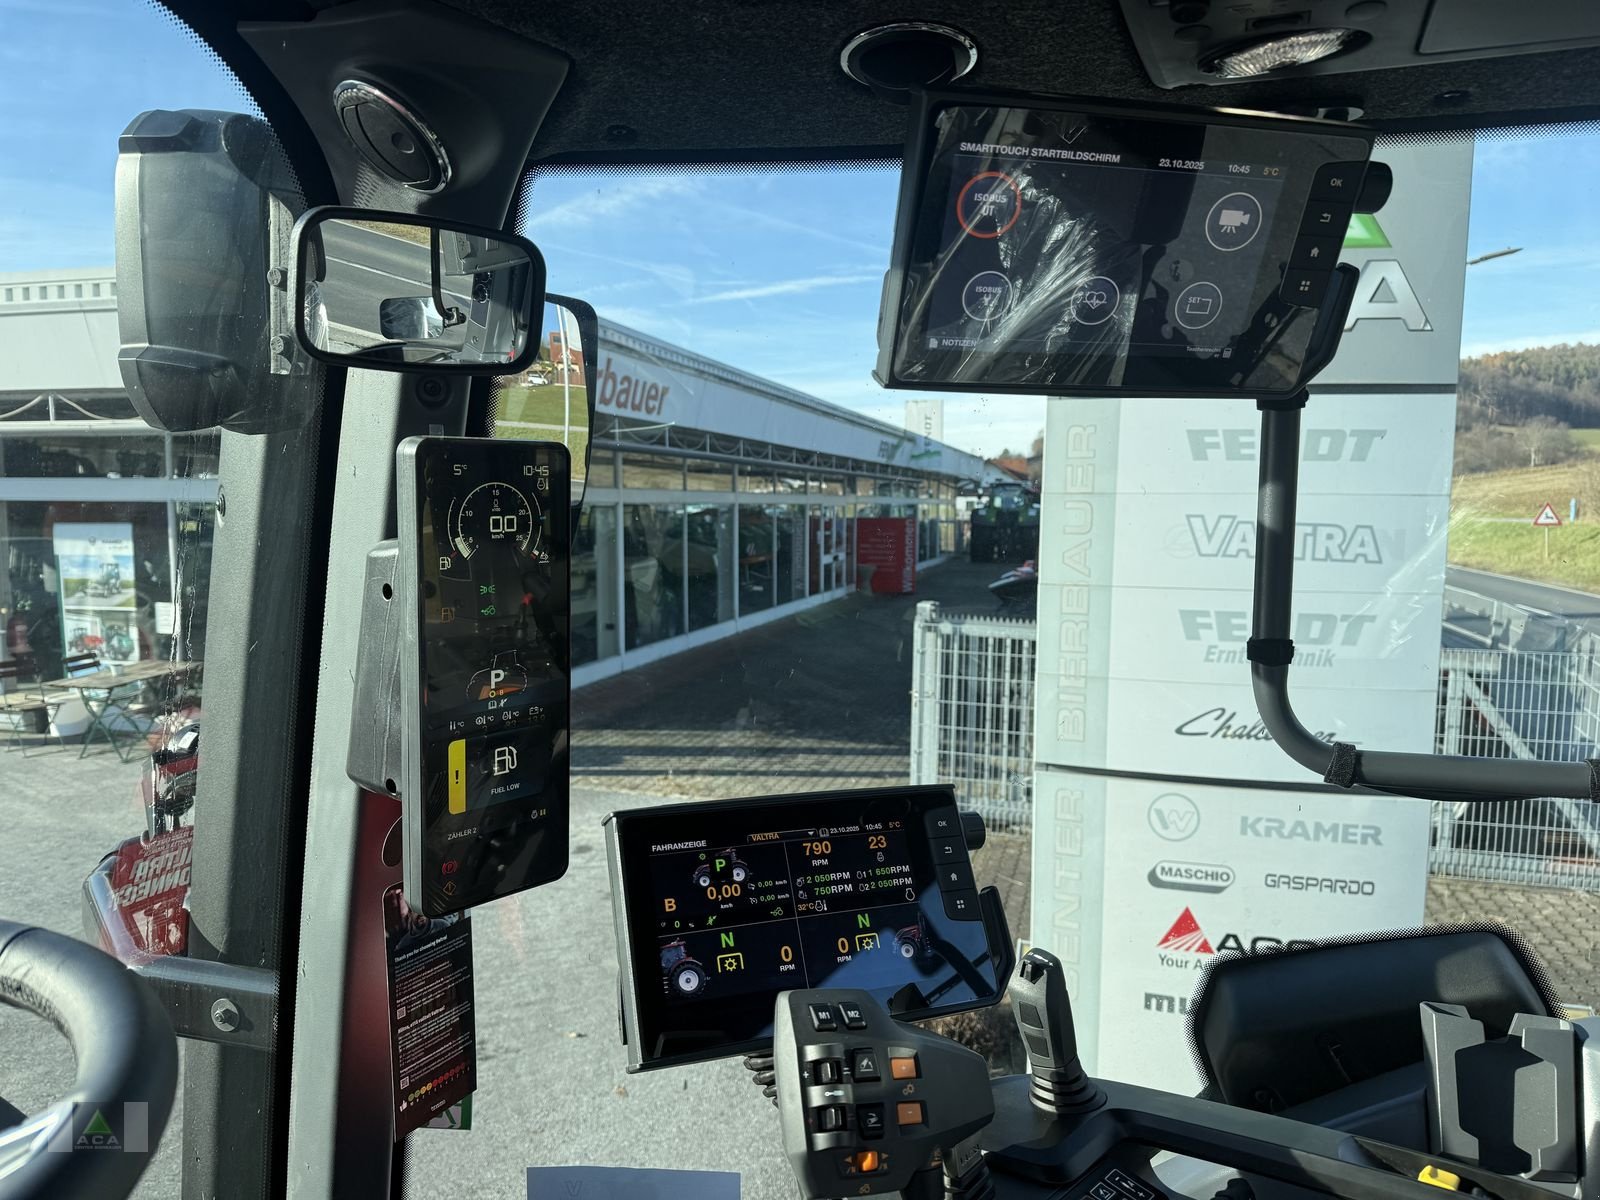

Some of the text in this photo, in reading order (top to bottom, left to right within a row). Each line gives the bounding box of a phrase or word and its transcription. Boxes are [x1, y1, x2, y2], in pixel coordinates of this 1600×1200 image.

[960, 142, 1120, 163] SMARTTOUCH STARTBILDSCHIRM
[1158, 158, 1280, 176] 23.10.2025 10:45 5°C
[1330, 178, 1343, 187] OK
[941, 339, 977, 347] NOTIZEN
[1185, 429, 1388, 462] FEDT
[453, 464, 468, 476] 5°C
[523, 465, 550, 476] 10:45
[1185, 514, 1383, 564] VATRA
[1057, 424, 1097, 743] BIERBAUER
[1178, 609, 1377, 647] FEDT
[491, 669, 505, 689] P
[491, 782, 521, 795] FUEL LOW
[830, 825, 860, 834] 23.10.2025
[866, 823, 883, 831] 10:45
[1240, 815, 1383, 846] KRAMER
[751, 832, 780, 841] VALTRA
[868, 836, 887, 849] 23
[651, 840, 707, 852] FAHRANZEIGE
[802, 841, 832, 856] 790
[715, 859, 726, 872] P
[812, 859, 829, 867] RPM
[1160, 865, 1231, 883] MASCHIO
[758, 880, 773, 888] 0,00
[1264, 873, 1375, 896] GASPARDO
[707, 884, 741, 902] 0,00
[664, 898, 677, 912] B
[798, 902, 815, 911] 32°C
[857, 913, 871, 929] N
[720, 932, 735, 948] N
[837, 937, 849, 954] 0
[781, 945, 793, 962] 0
[837, 955, 852, 963] RPM
[779, 964, 796, 972] RPM
[1158, 953, 1189, 969] Your
[818, 1011, 831, 1020] M1
[849, 1010, 860, 1018] M2
